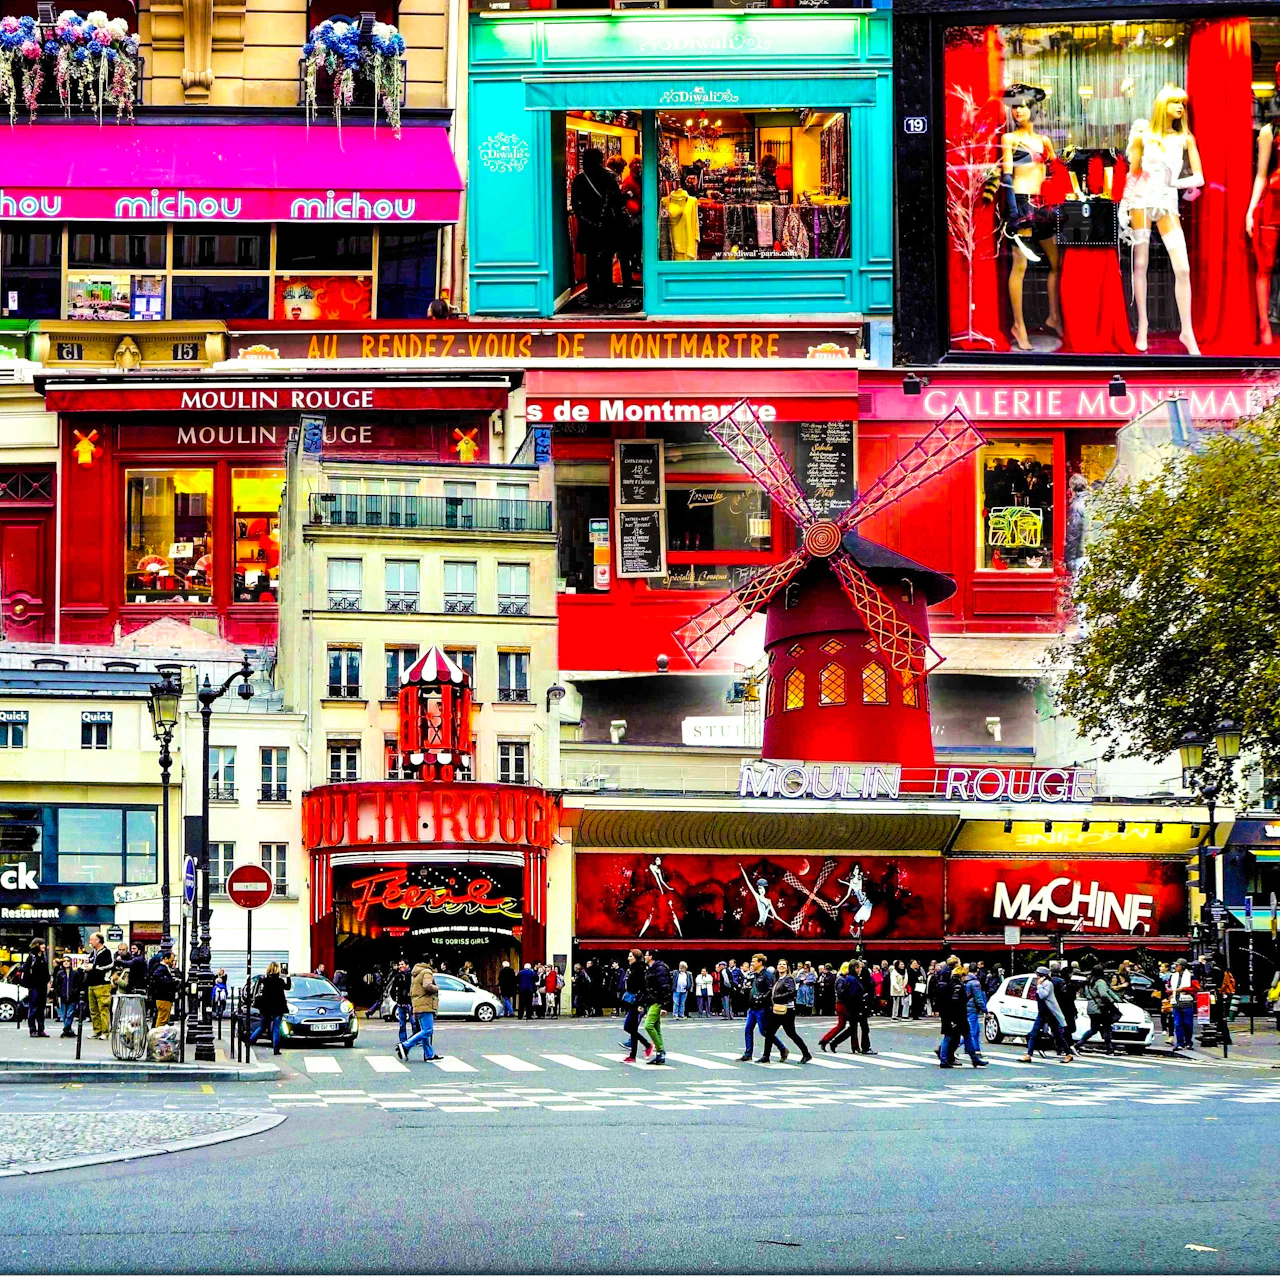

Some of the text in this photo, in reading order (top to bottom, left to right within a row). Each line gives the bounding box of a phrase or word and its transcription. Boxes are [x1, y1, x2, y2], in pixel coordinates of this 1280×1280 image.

[681, 90, 718, 102] Diwali
[908, 120, 924, 131] 19
[116, 189, 242, 218] michou
[290, 190, 416, 219] michou
[182, 391, 374, 407] MOULIN ROUGE
[925, 390, 1062, 417] GALERIE
[178, 426, 276, 445] MOULIN
[82, 712, 112, 723] Quick
[741, 765, 1097, 802] MOULIN ROUGE
[307, 791, 550, 849] OULIN ROUG
[2, 907, 60, 919] Restaurant
[993, 878, 1154, 932] MACHINE
